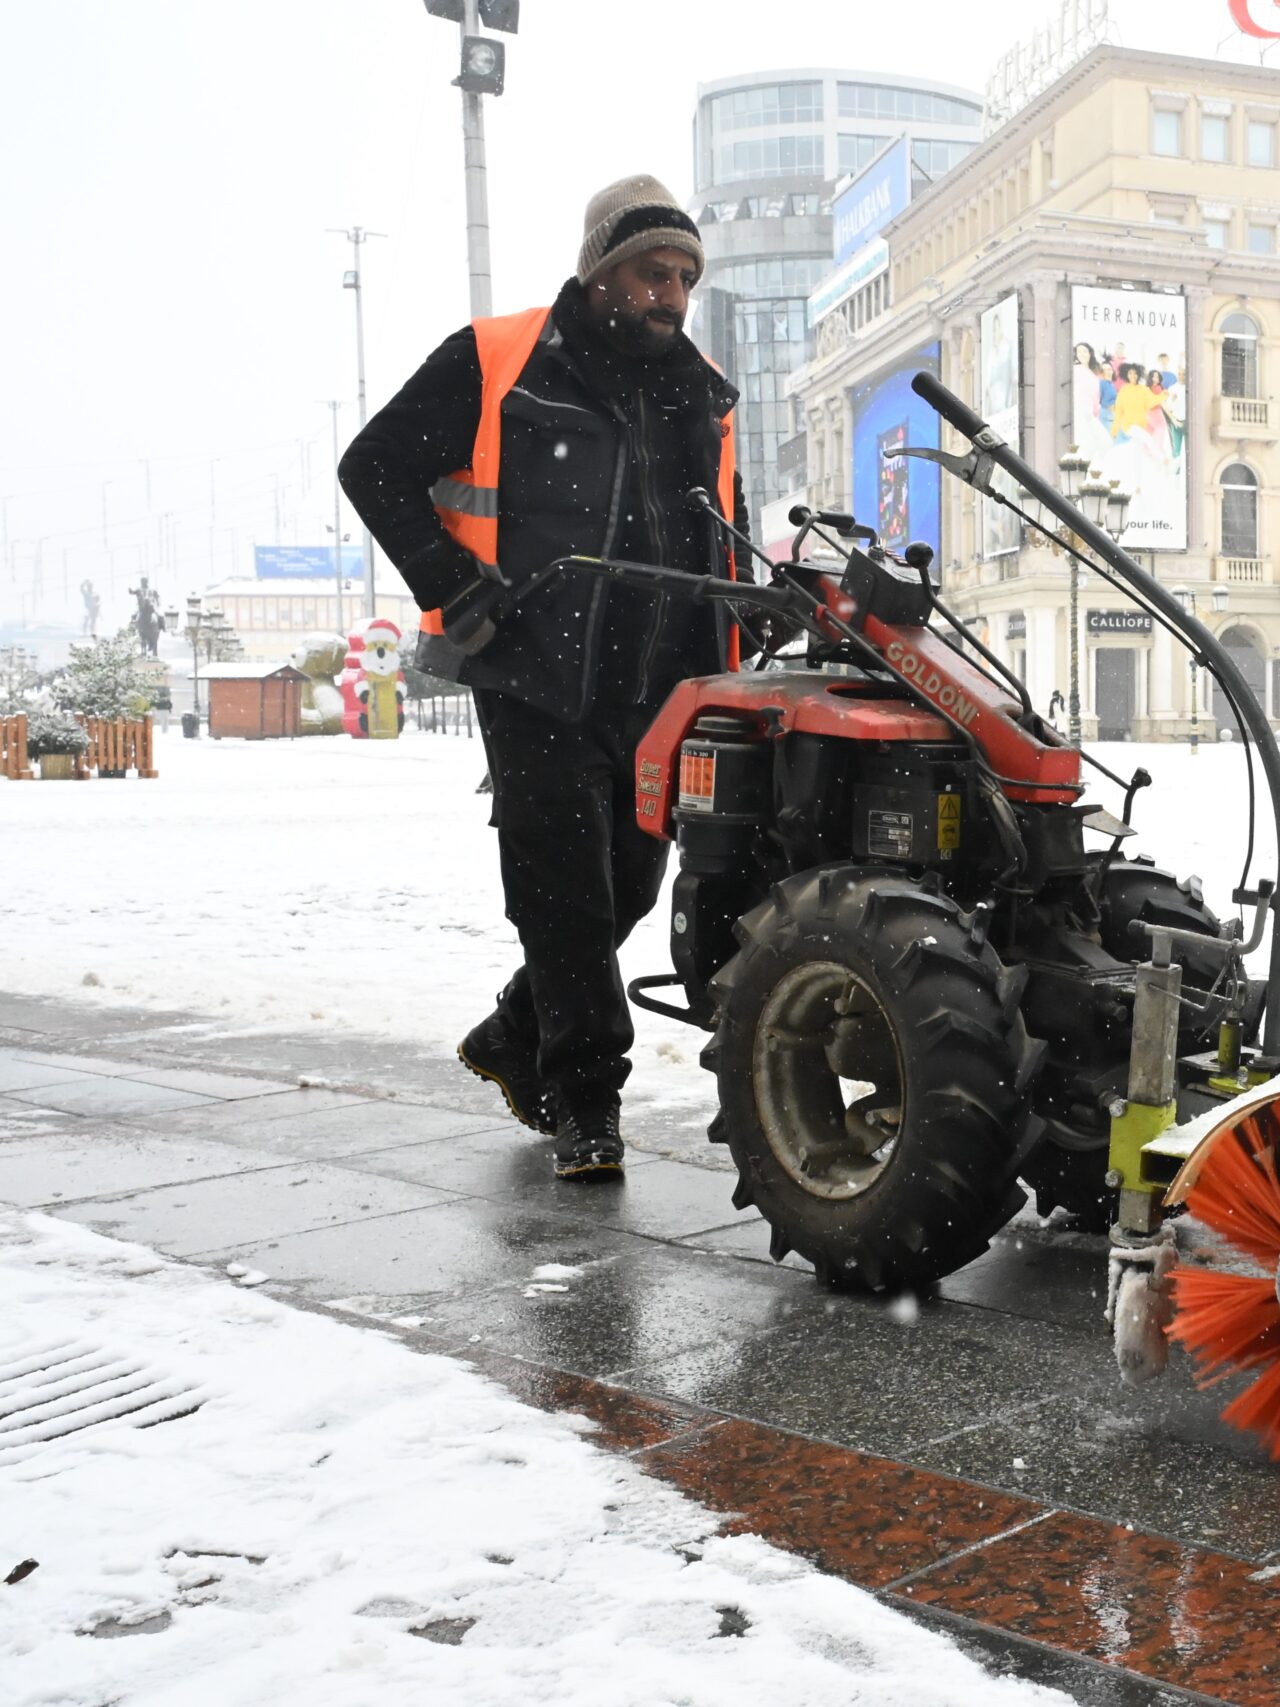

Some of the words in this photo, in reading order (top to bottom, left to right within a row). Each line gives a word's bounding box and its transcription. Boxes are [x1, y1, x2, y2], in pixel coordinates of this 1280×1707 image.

[1081, 305, 1177, 328] TERRANOVA
[1151, 519, 1173, 531] life.
[1090, 616, 1151, 628] CALLIOPE
[887, 641, 978, 725] GOLDONI
[641, 799, 657, 817] 140
